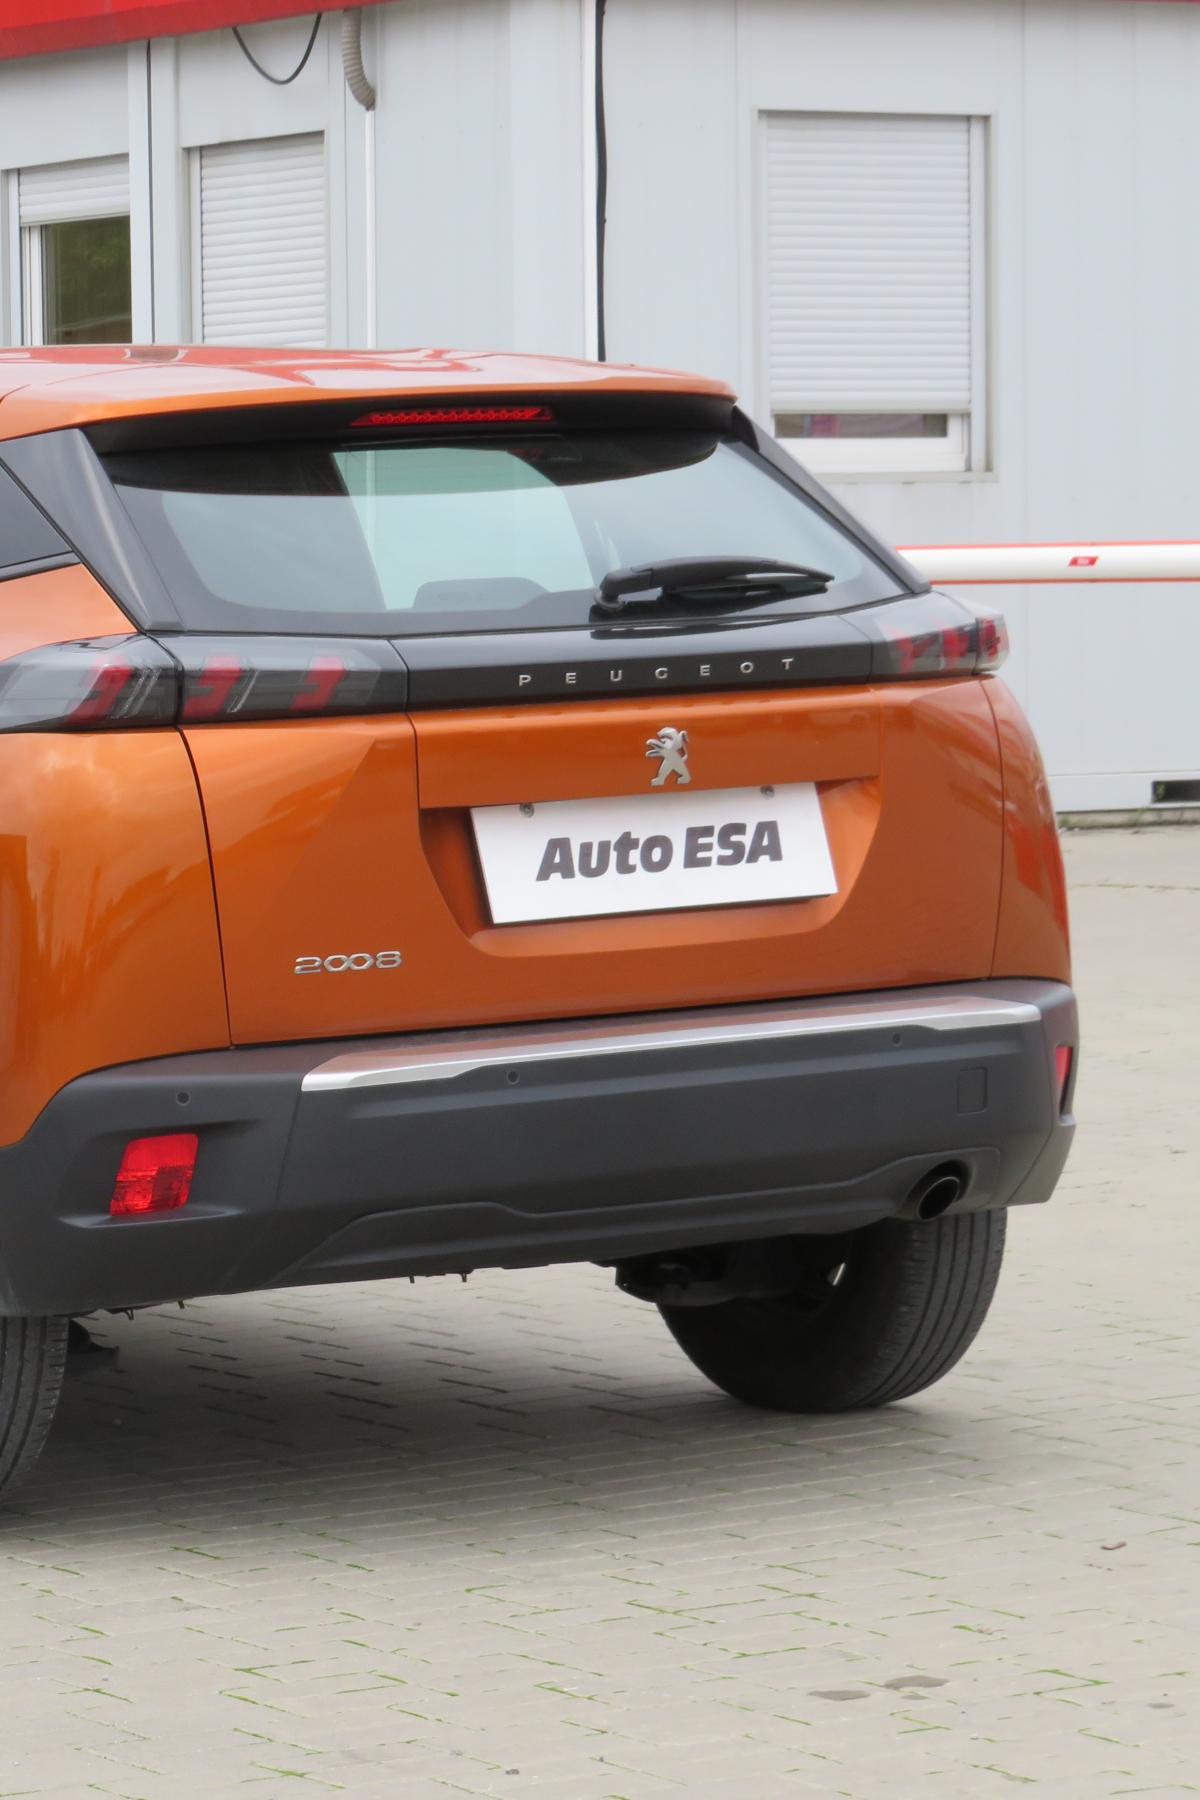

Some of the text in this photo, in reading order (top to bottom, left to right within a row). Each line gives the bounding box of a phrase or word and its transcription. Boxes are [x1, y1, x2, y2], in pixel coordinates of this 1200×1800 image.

[518, 658, 794, 687] PEUGEOT
[536, 820, 783, 882] Auto ESA
[294, 951, 401, 974] 2008
